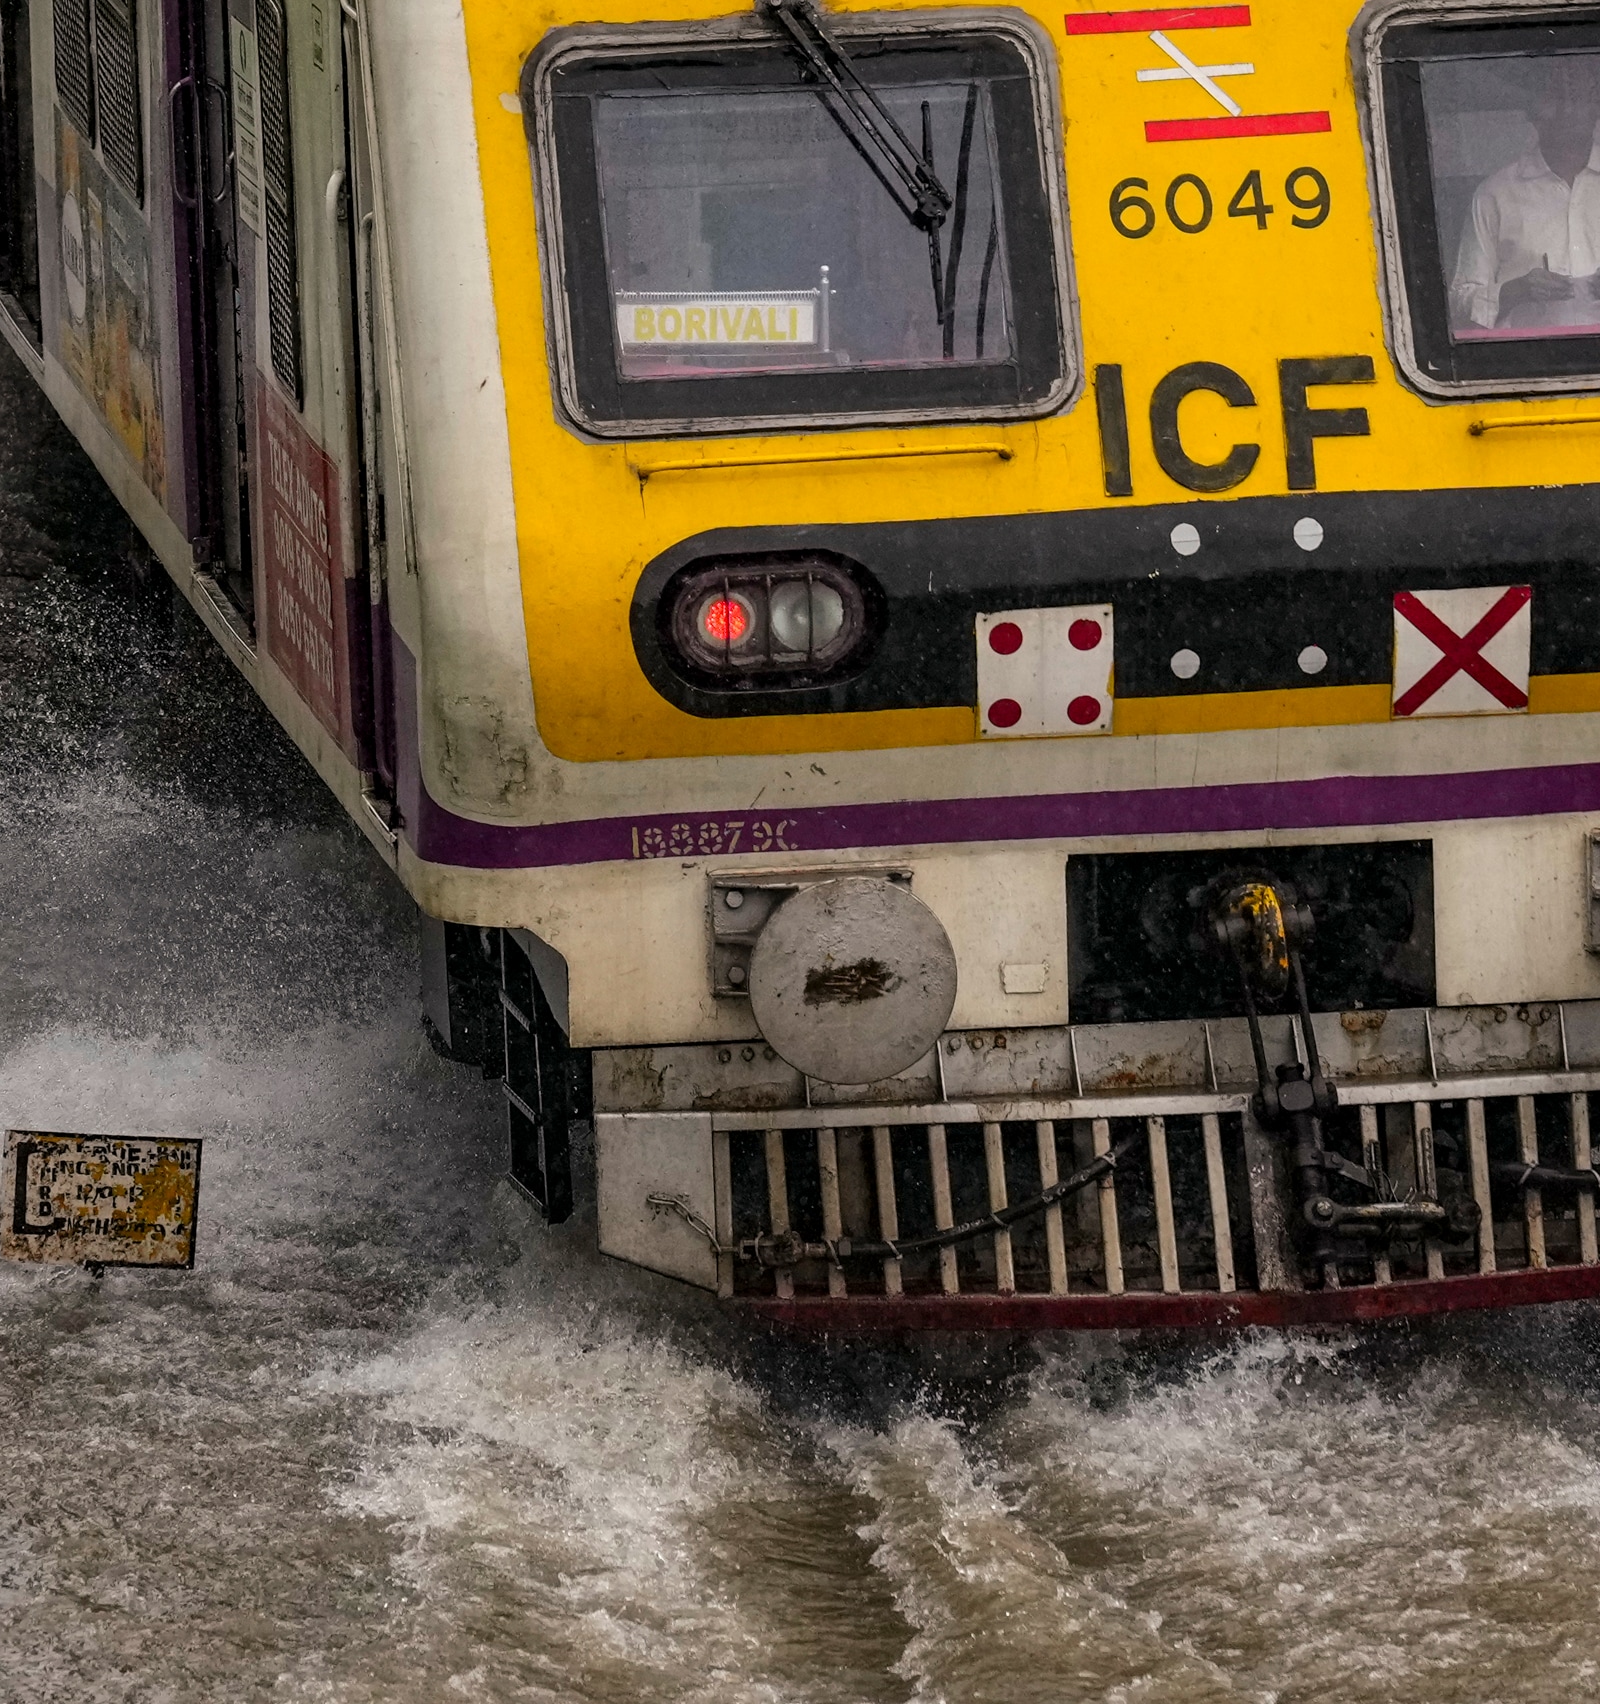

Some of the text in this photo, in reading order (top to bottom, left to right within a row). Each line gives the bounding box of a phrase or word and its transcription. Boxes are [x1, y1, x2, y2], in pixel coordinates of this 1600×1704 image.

[1109, 166, 1331, 239] 6049
[634, 306, 799, 342] BORIVALI
[1094, 355, 1377, 498] ICF
[267, 429, 296, 514] TELEX
[274, 508, 295, 579] 9819
[295, 538, 315, 605] 500
